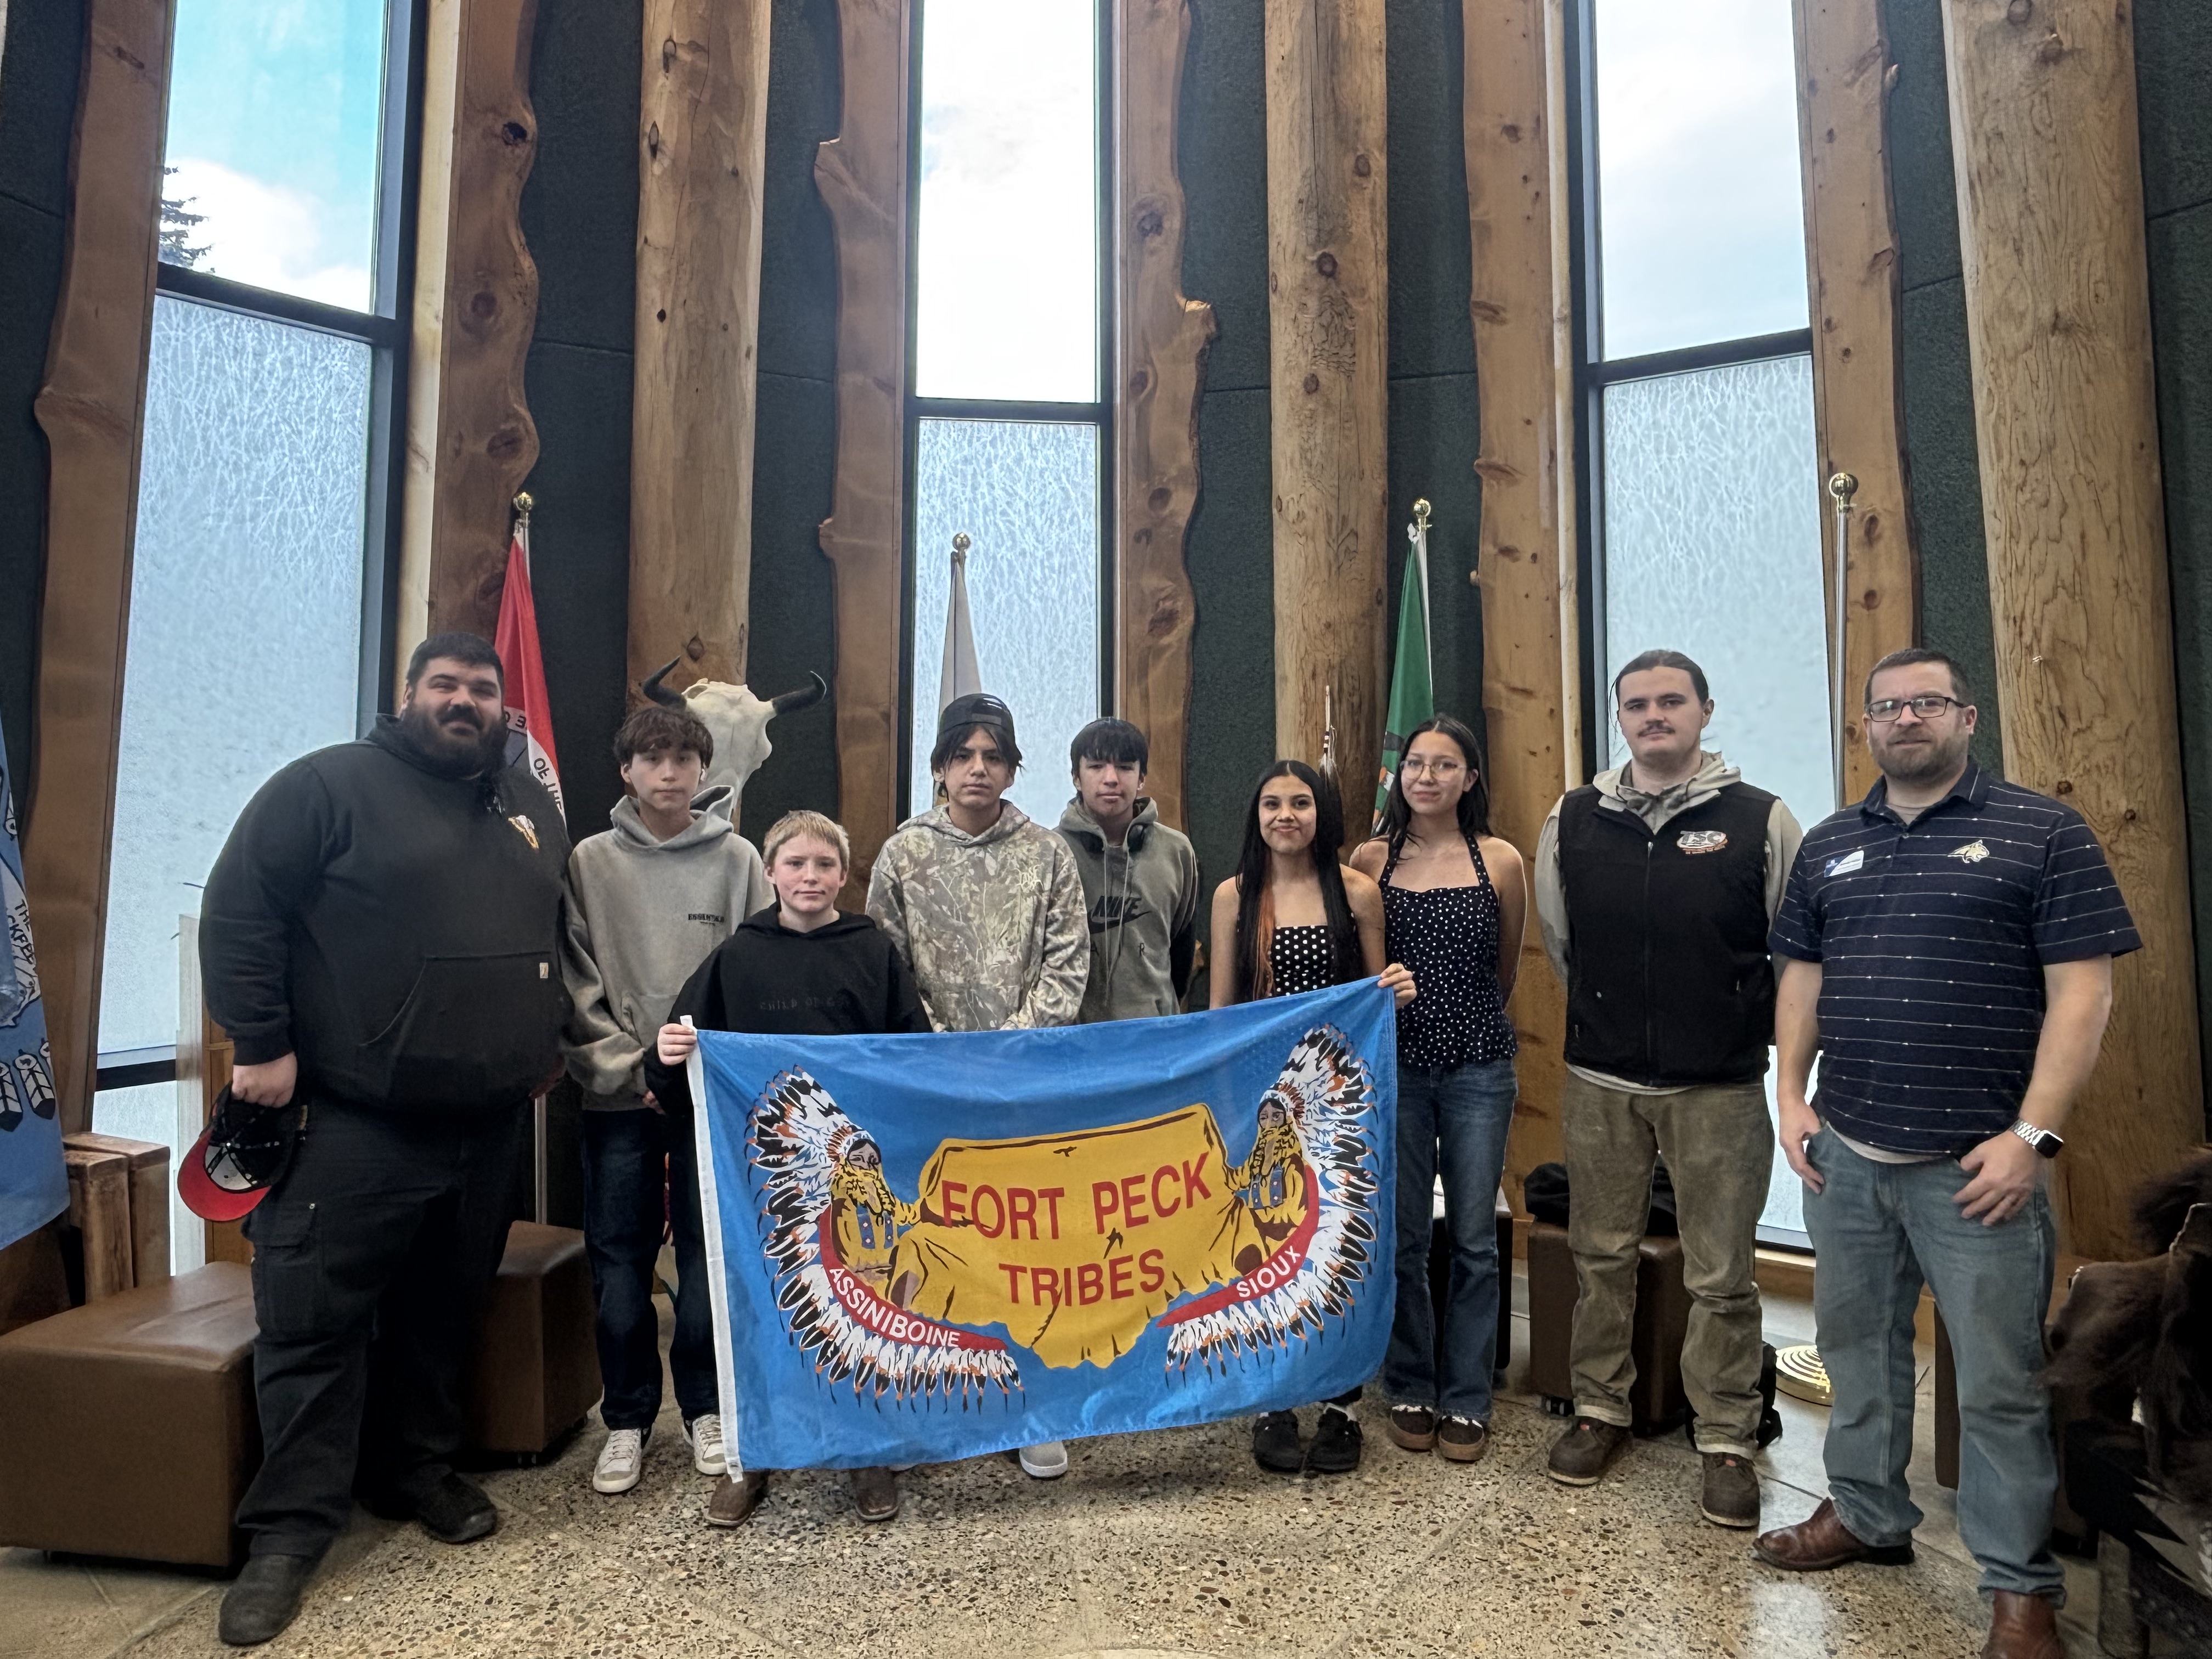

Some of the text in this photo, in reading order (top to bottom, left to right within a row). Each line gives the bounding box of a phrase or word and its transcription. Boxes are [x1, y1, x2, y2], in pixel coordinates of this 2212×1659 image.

[1092, 895, 1142, 917] NIKE
[941, 1151, 1211, 1240] FORT PECK
[998, 1249, 1165, 1307] TRIBES
[1236, 1245, 1301, 1297] SIOUX
[829, 1268, 961, 1347] ASSINIBOINE
